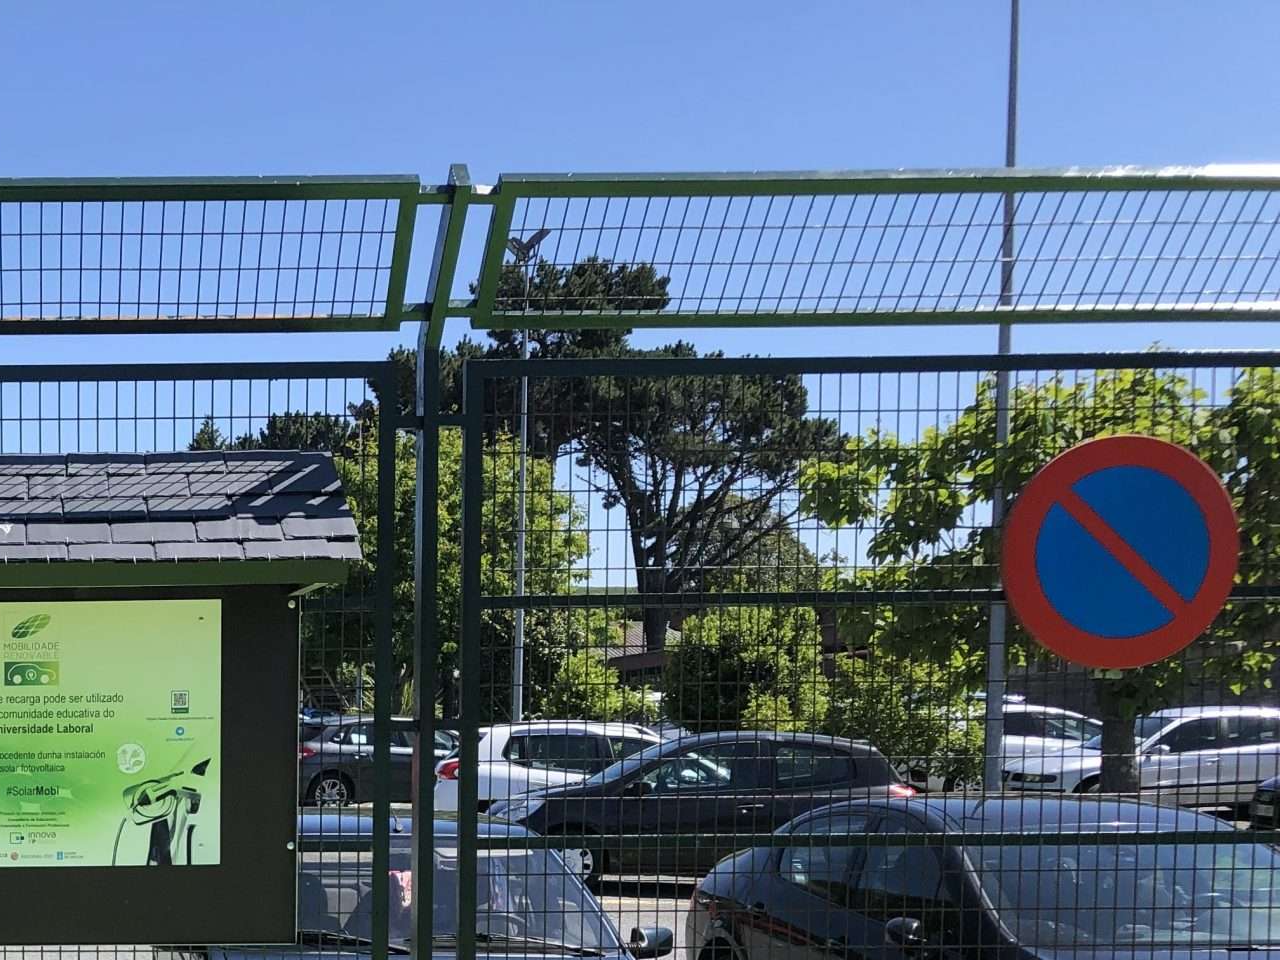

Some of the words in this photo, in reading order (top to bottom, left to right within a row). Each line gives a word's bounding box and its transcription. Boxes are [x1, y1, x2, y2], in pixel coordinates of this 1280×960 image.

[3, 641, 60, 651] MOBILIDADE
[6, 695, 40, 706] recarga
[43, 693, 66, 705] pode
[69, 695, 83, 704] ser
[86, 692, 124, 703] utilizado
[56, 708, 101, 718] educativa
[103, 708, 115, 718] do
[56, 723, 94, 734] Laboral
[38, 751, 61, 760] dunha
[64, 749, 106, 760] instalación
[0, 763, 18, 773] solar
[20, 763, 65, 773] fotovoltaica
[6, 785, 60, 796] #SolarMobi
[28, 831, 57, 839] innova
